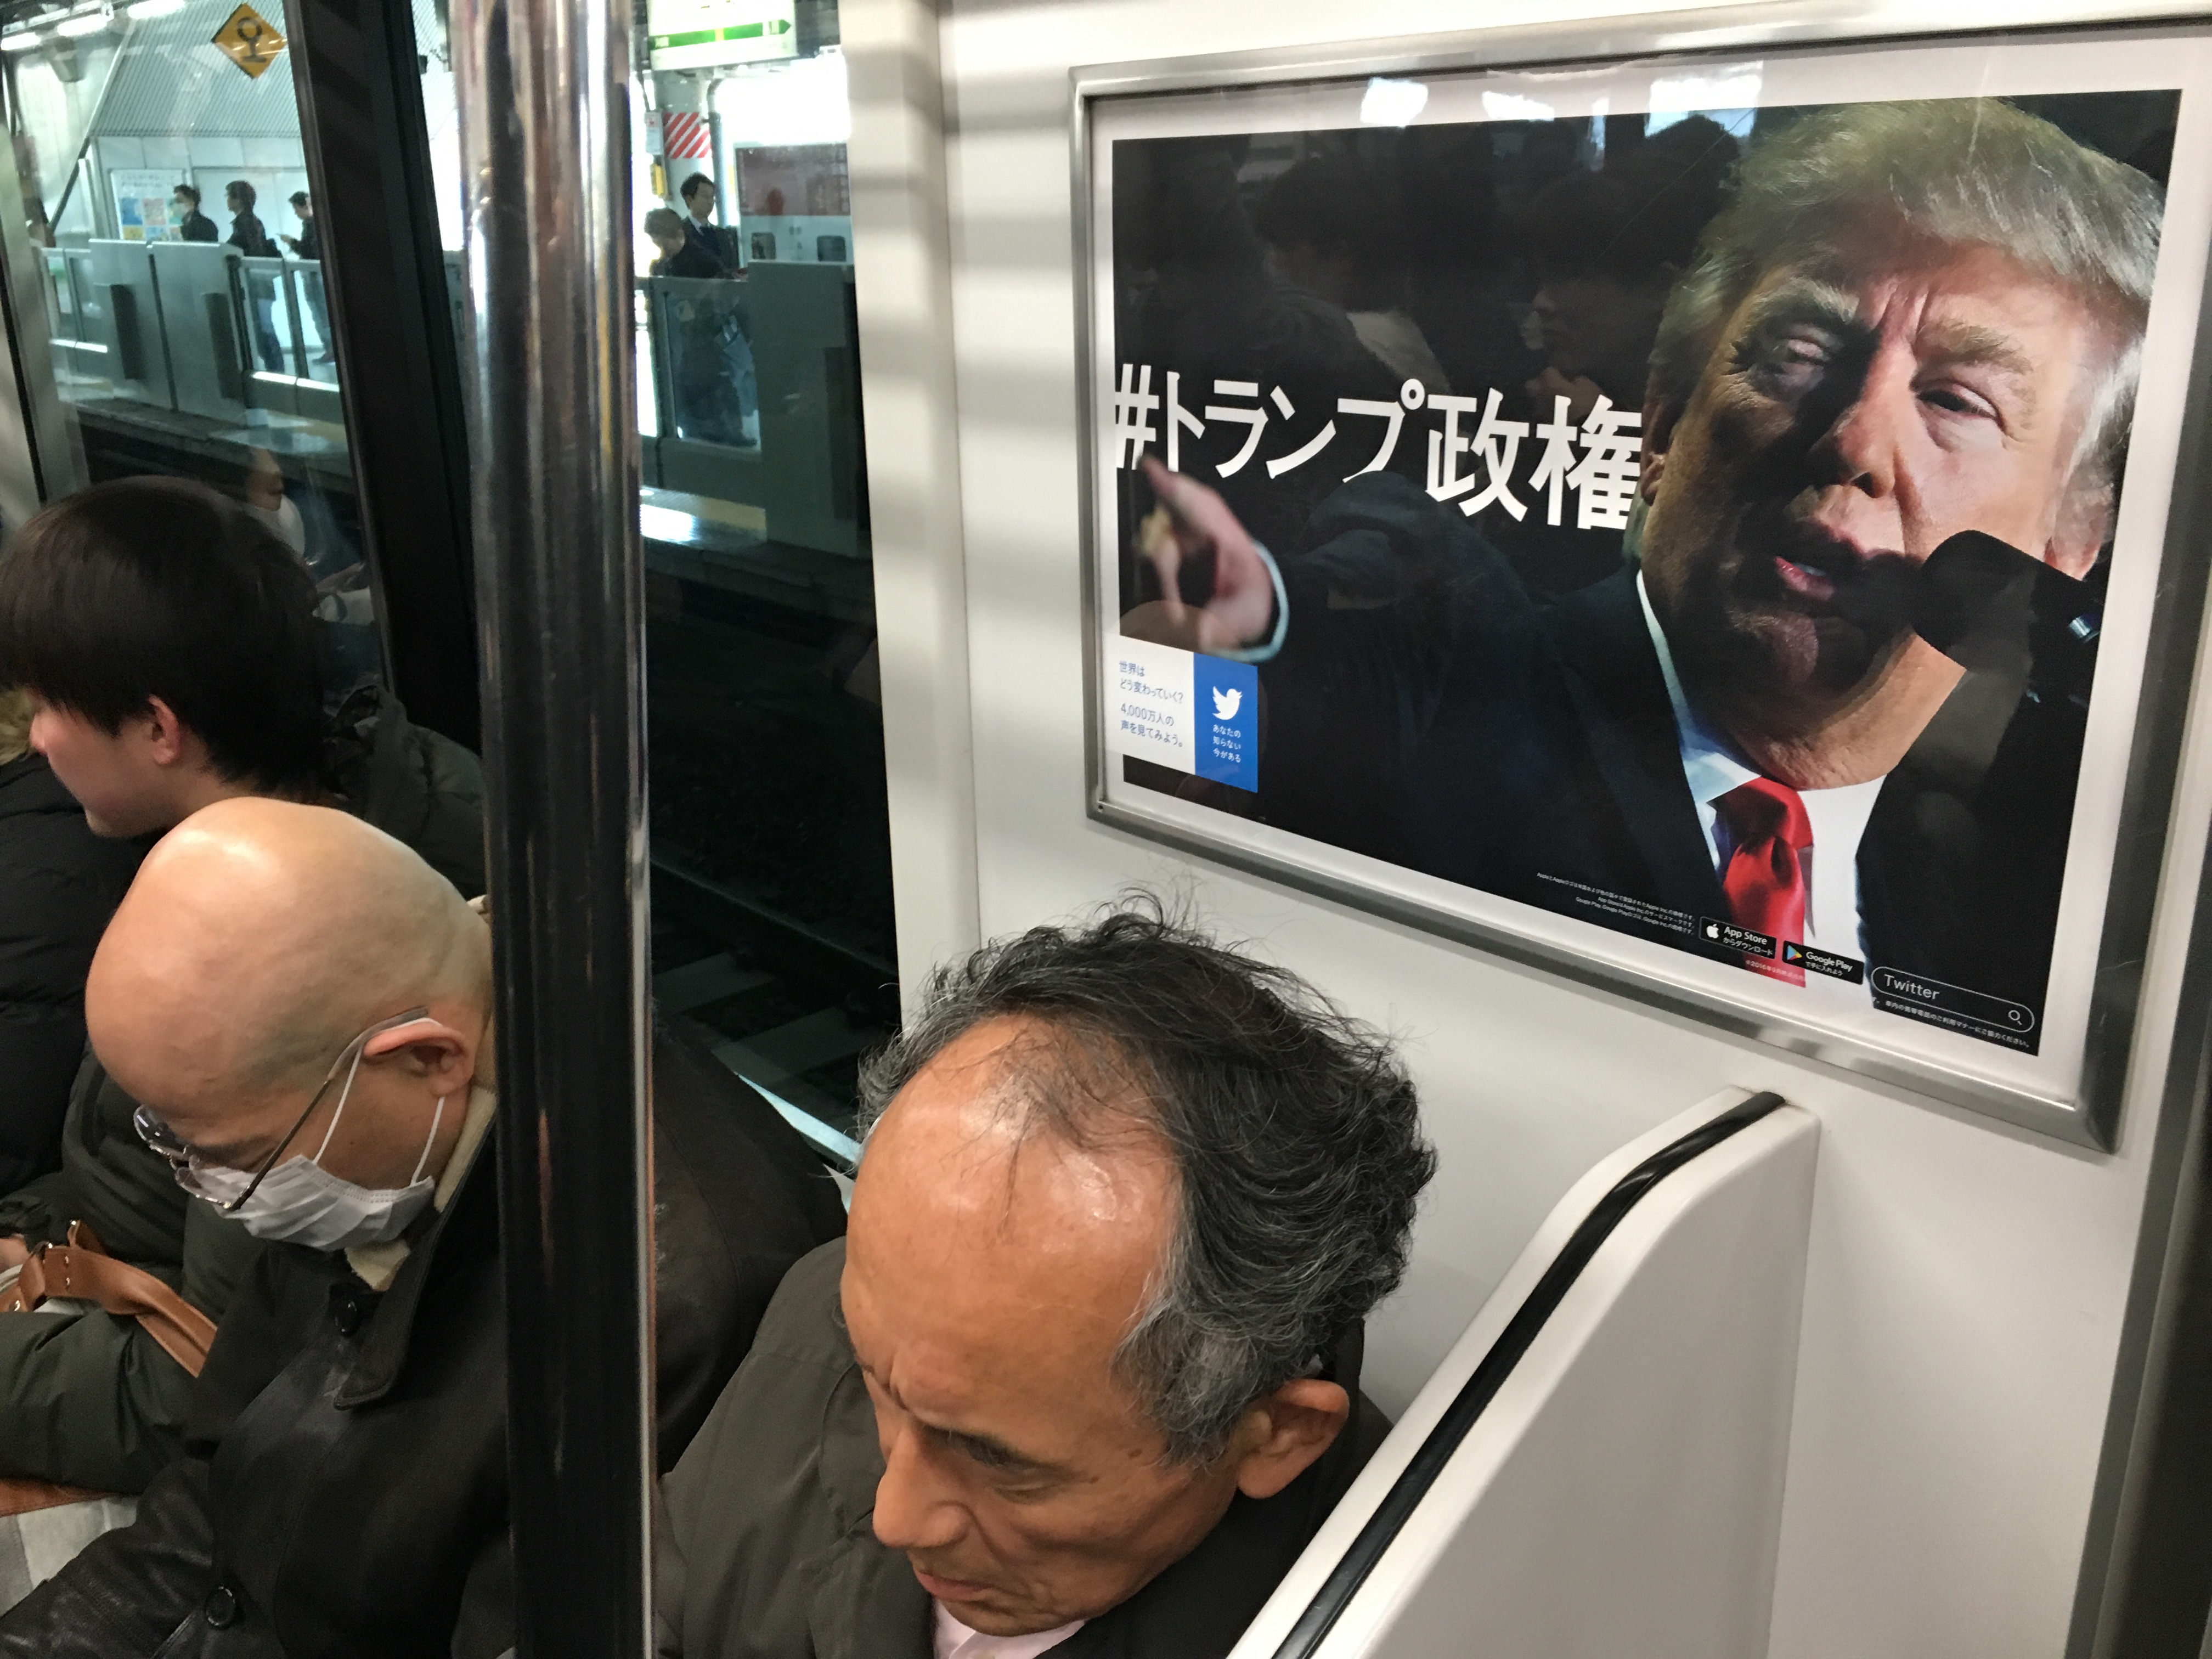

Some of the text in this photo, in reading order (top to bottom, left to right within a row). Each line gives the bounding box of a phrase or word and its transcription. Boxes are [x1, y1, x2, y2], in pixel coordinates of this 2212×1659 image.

[1115, 363, 1642, 530] #トランプ政権
[1119, 661, 1145, 676] 世界は
[1121, 703, 1174, 726] 4,000万人の
[1120, 719, 1183, 747] 声を見てみよう。
[1213, 724, 1241, 738] あなたの
[1213, 736, 1241, 749] 知らない
[1213, 748, 1241, 763] 今がある
[1724, 926, 1768, 945] App Store
[1723, 937, 1773, 956] からダウンロード
[1805, 951, 1853, 973] Google Play
[1805, 961, 1843, 977] で手に入れよう
[1884, 974, 1940, 1000] Twitter
